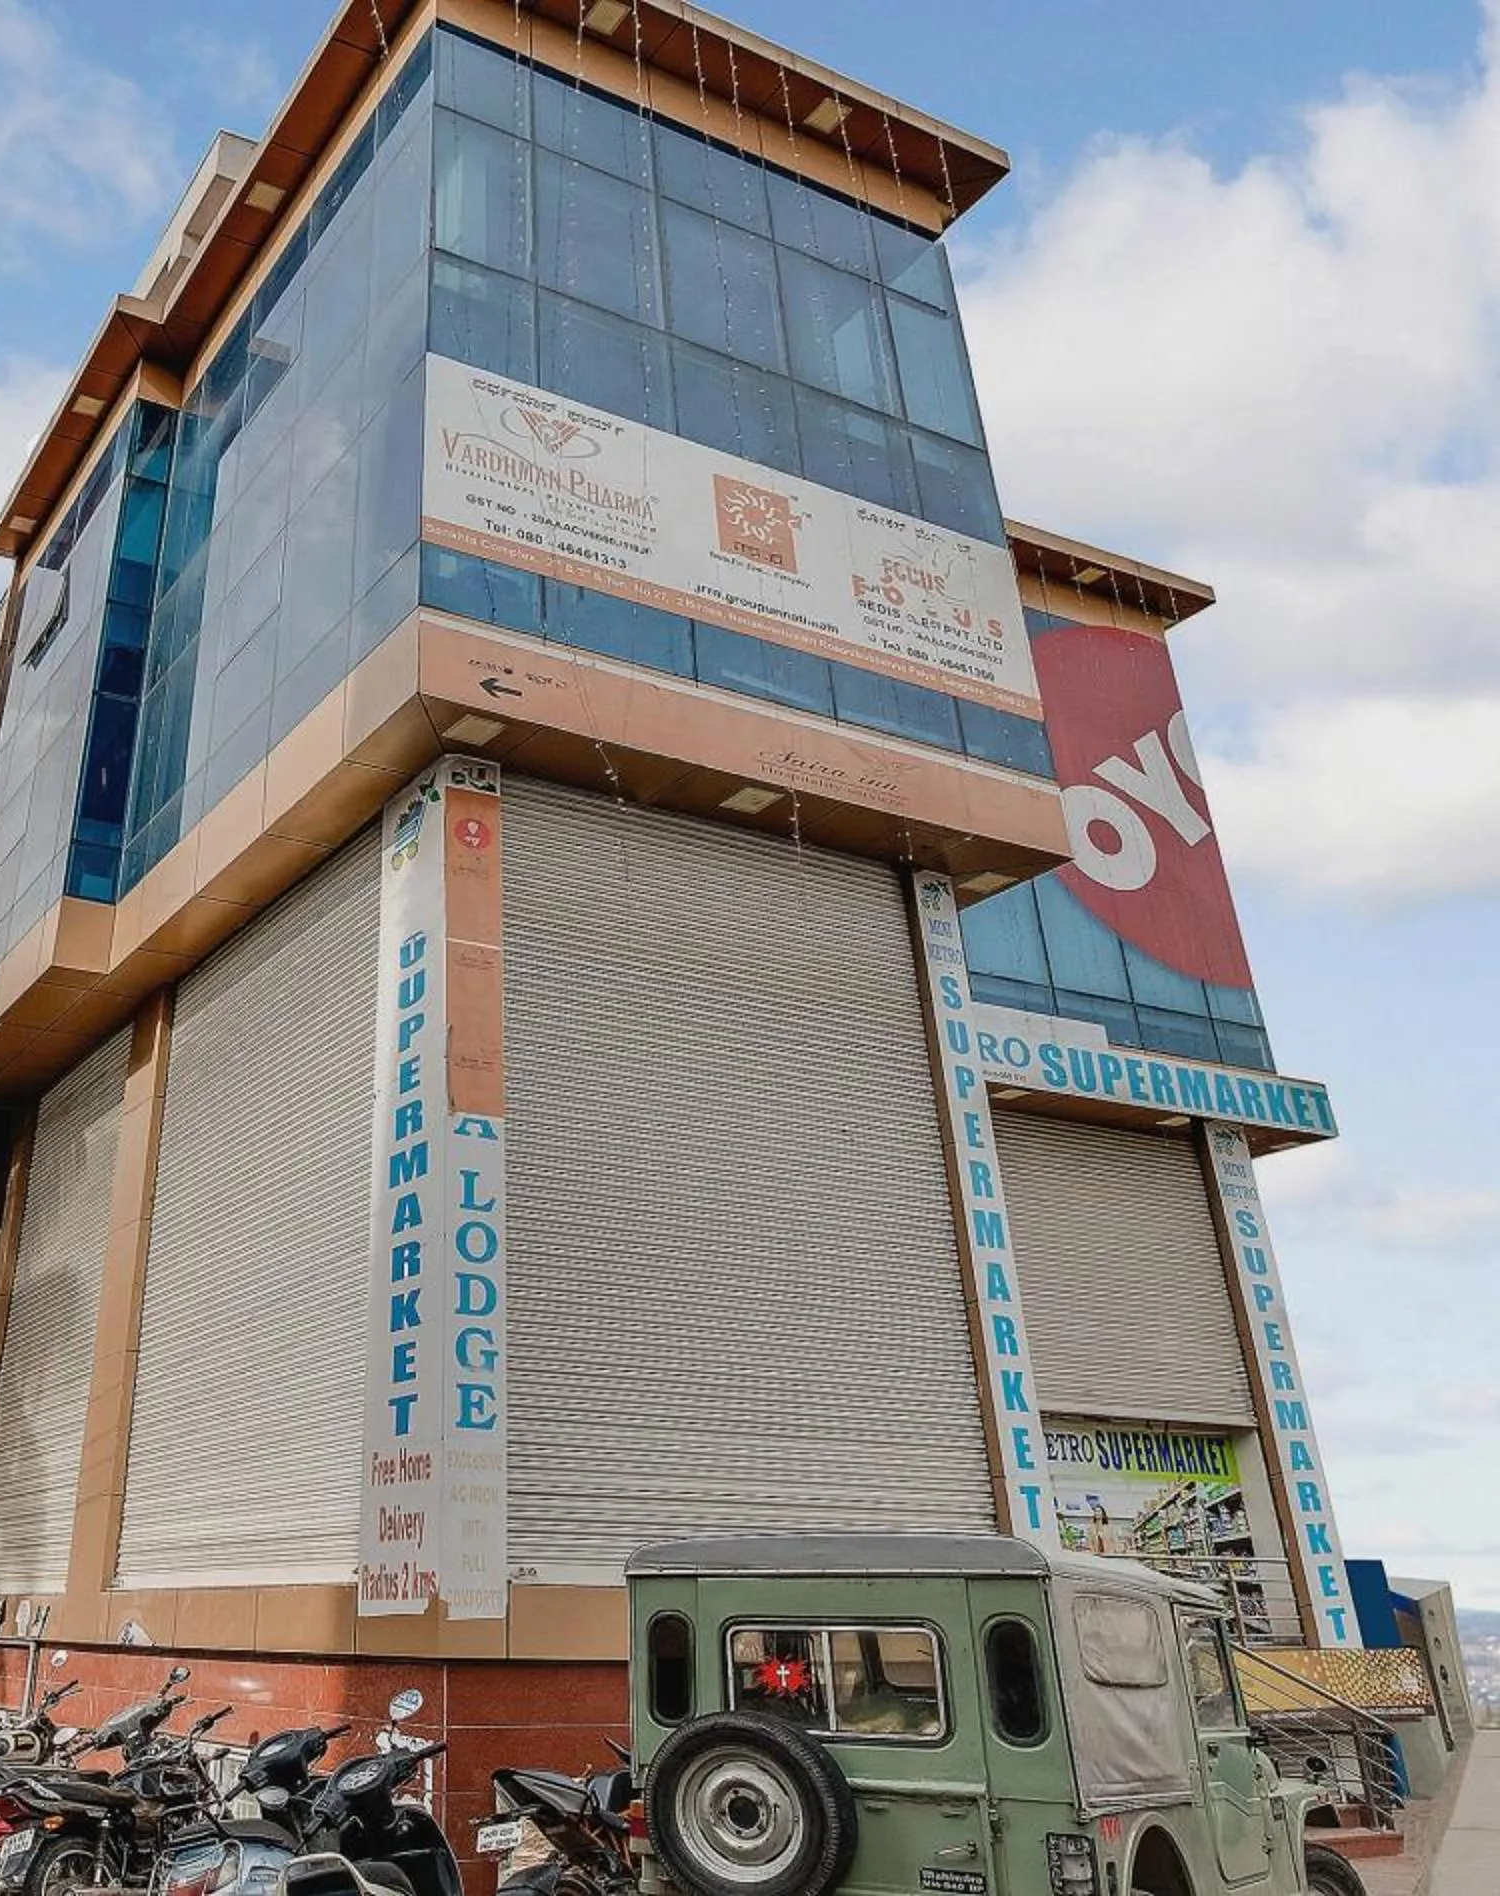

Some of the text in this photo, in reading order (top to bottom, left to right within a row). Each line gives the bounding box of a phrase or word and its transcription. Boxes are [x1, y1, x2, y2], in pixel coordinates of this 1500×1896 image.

[442, 427, 653, 521] VARDHMAN PHARMA
[465, 493, 493, 509] GST
[1037, 1042, 1333, 1130] SUPERMARKET
[939, 974, 1042, 1529] SUPERMARKET
[454, 1169, 499, 1431] LODGE
[370, 1447, 432, 1487] Free Home
[1095, 1429, 1229, 1476] SUPERMARKET
[1234, 1207, 1347, 1643] SUPERMARKET
[378, 1506, 426, 1550] Delivery
